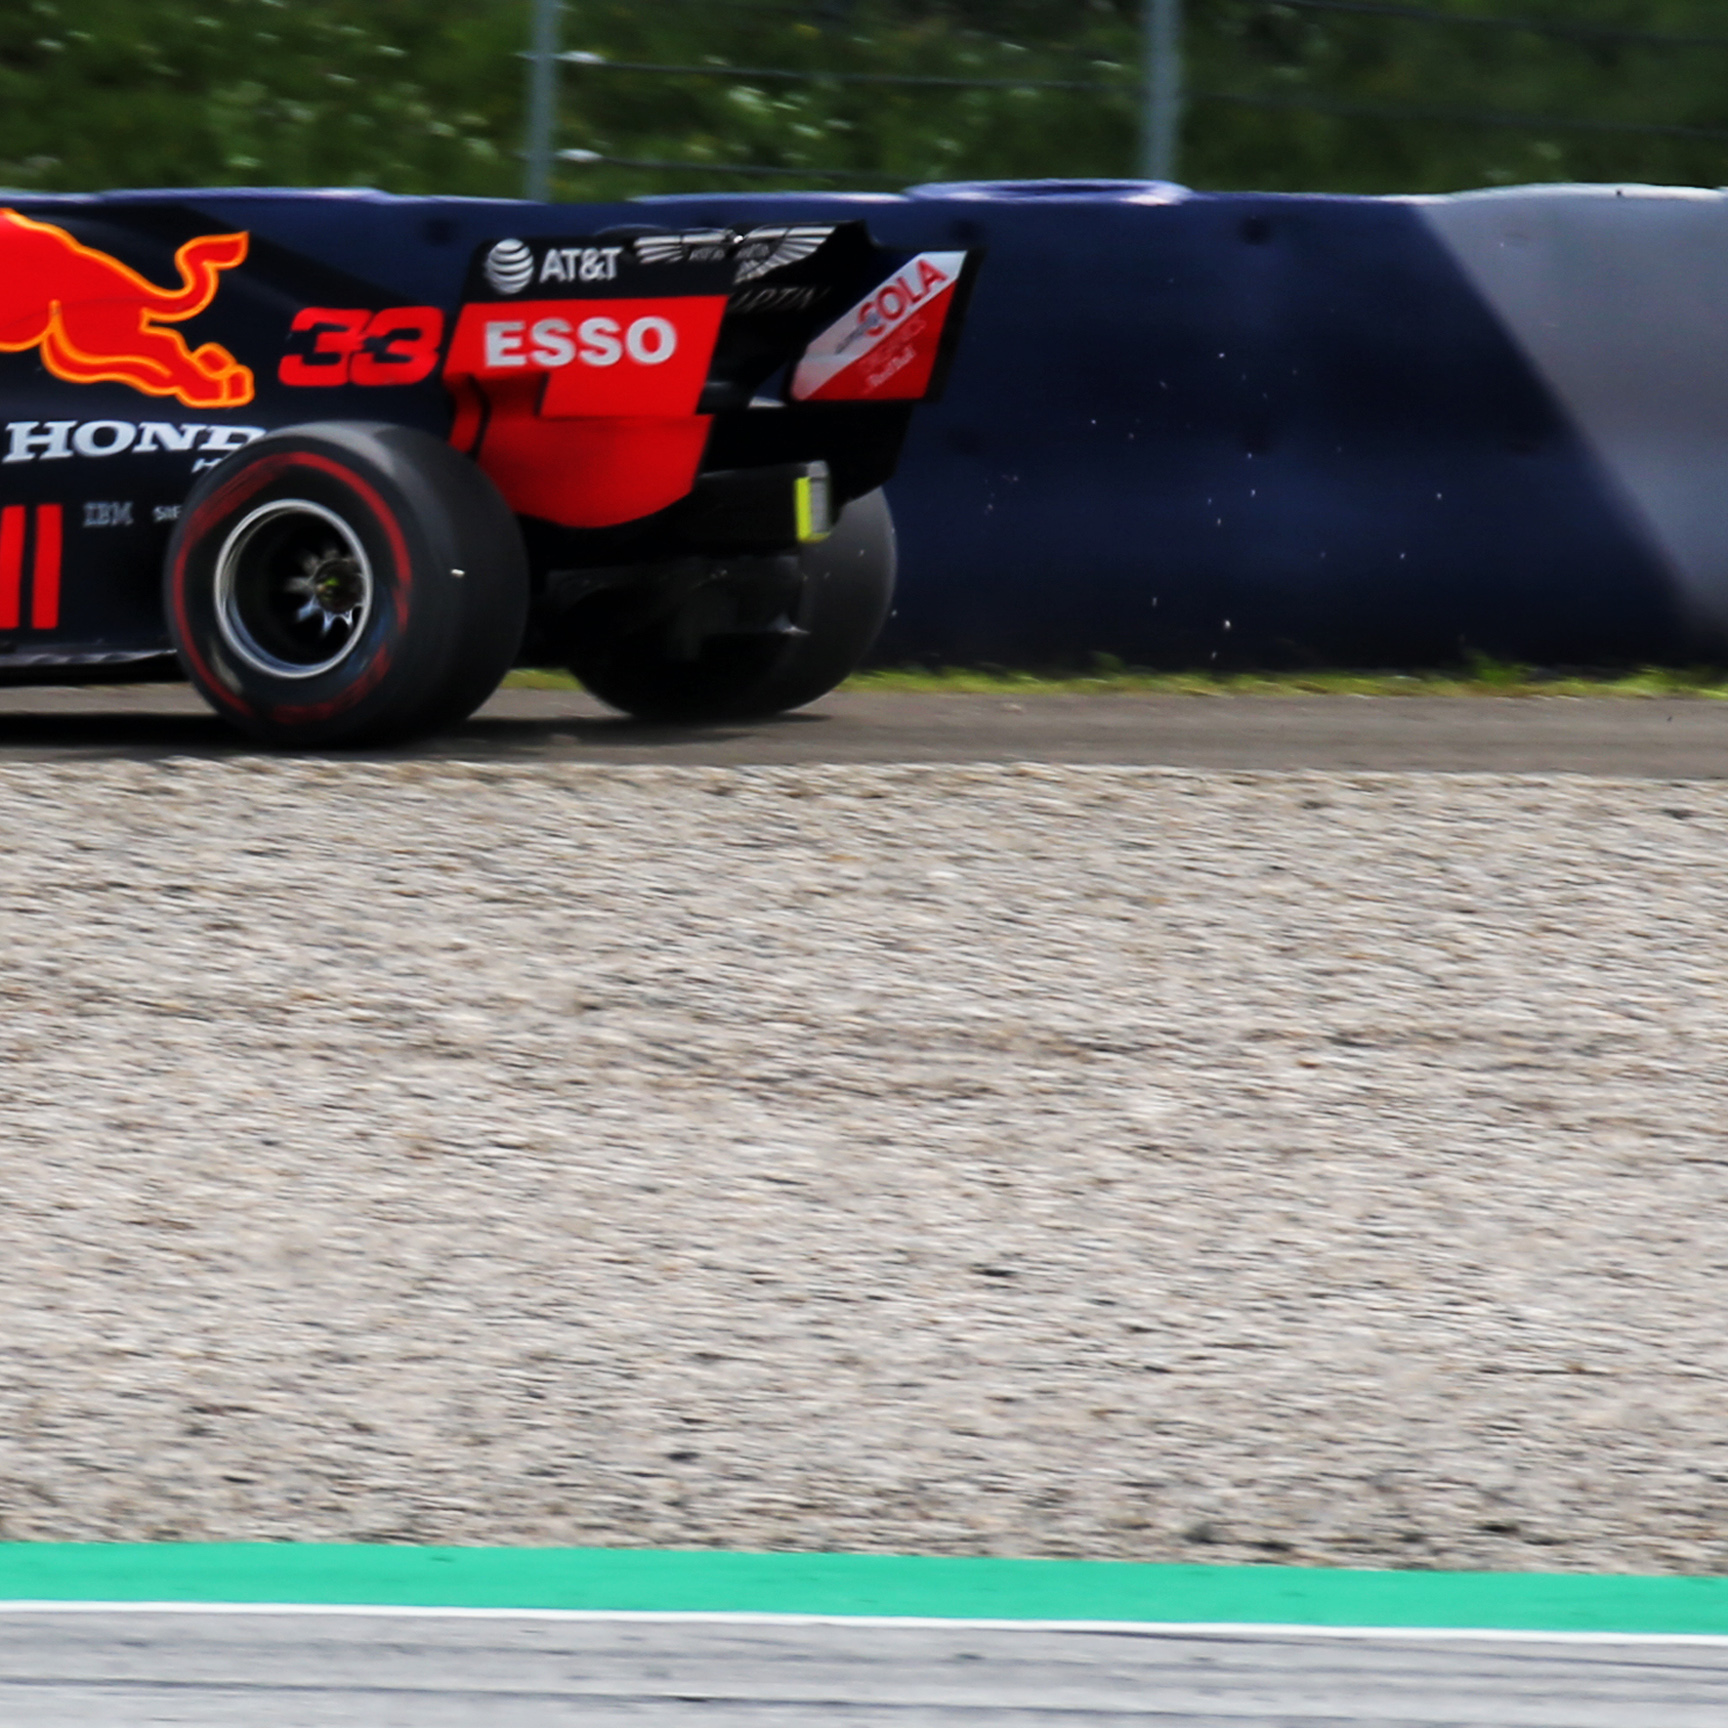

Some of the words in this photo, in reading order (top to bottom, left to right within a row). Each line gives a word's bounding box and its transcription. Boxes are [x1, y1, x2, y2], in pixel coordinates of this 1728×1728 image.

[539, 247, 623, 283] AT&T
[857, 258, 949, 338] COLA
[277, 306, 444, 387] 33
[484, 316, 676, 368] ESSO
[1, 420, 266, 464] HOND
